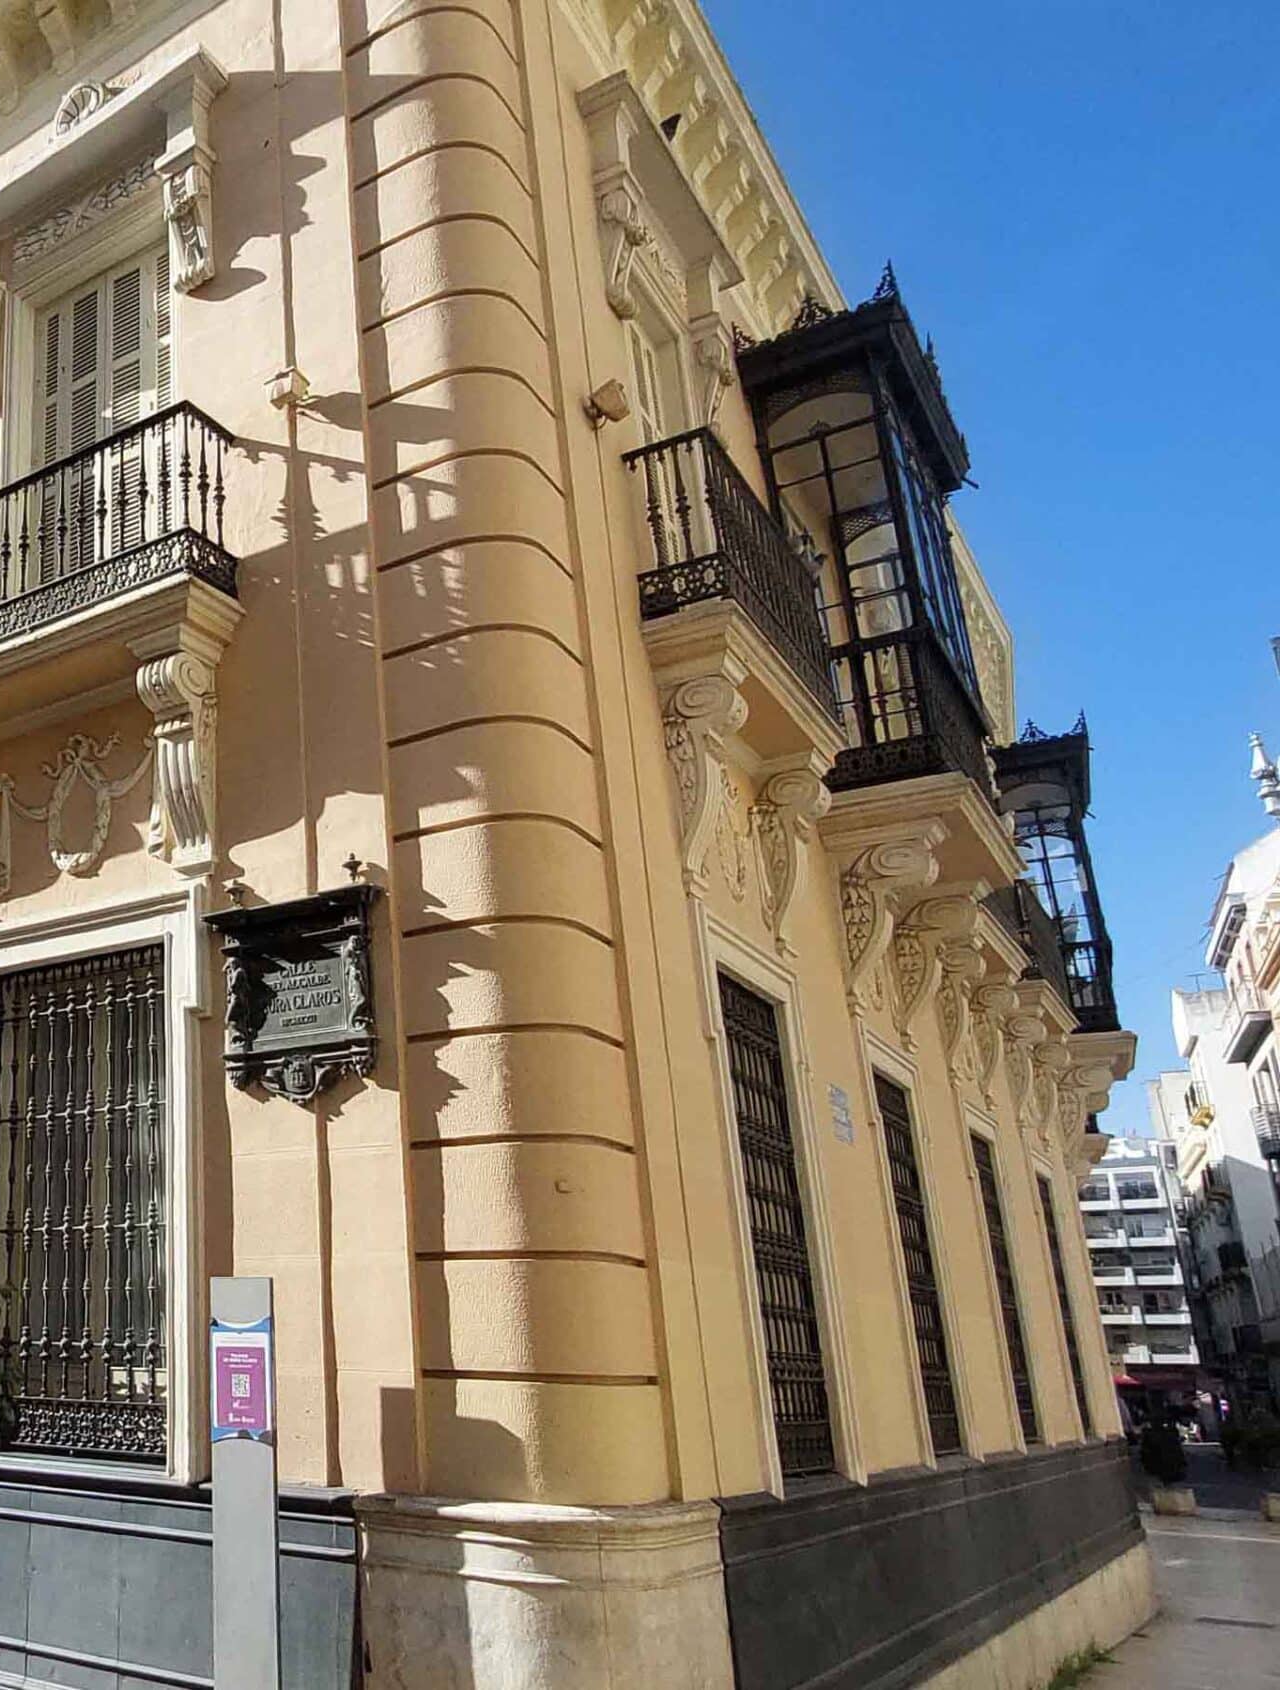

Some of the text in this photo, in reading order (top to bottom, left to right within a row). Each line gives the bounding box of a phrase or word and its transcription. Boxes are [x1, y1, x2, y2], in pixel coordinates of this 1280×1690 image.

[280, 960, 317, 978] CALLE
[287, 975, 331, 990] ALCALDE
[263, 990, 342, 1015] ORA CLAROS
